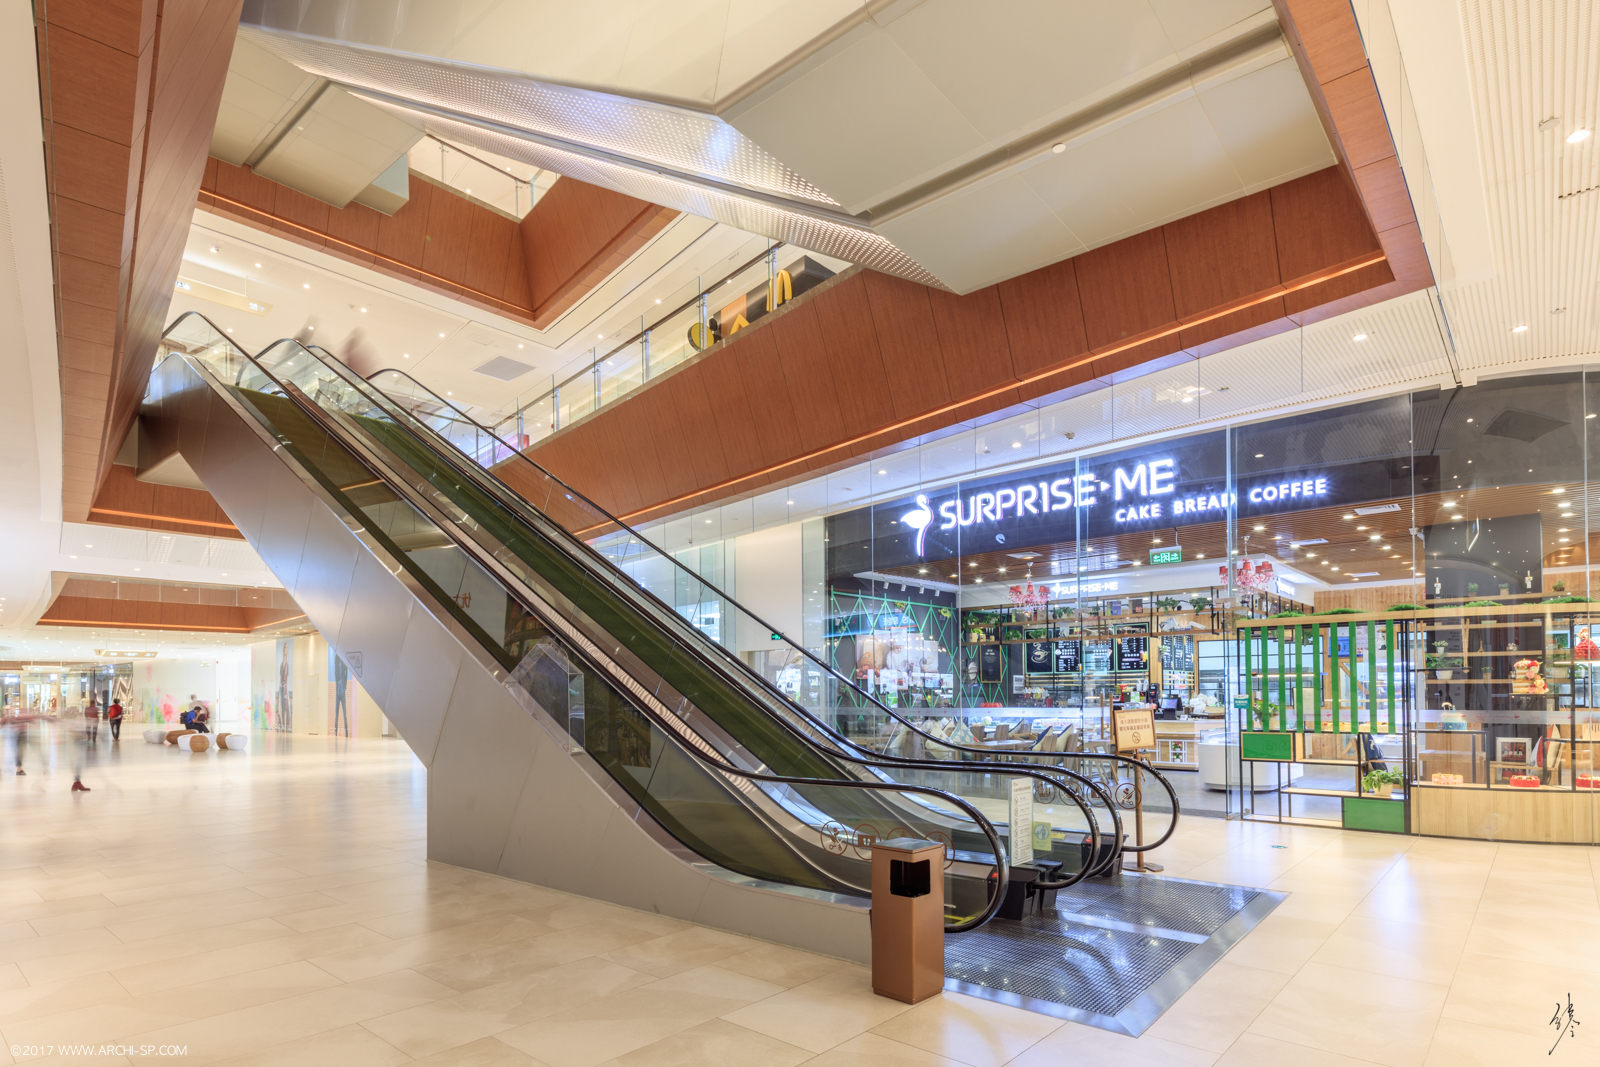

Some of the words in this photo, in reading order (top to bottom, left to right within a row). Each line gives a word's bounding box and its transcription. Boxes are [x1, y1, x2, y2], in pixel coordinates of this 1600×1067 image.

[940, 473, 1096, 530] SURPRISE
[1114, 458, 1175, 501] ME
[1115, 504, 1161, 522] CAKE
[1173, 492, 1236, 514] BREAD
[1249, 478, 1327, 502] COFFEE
